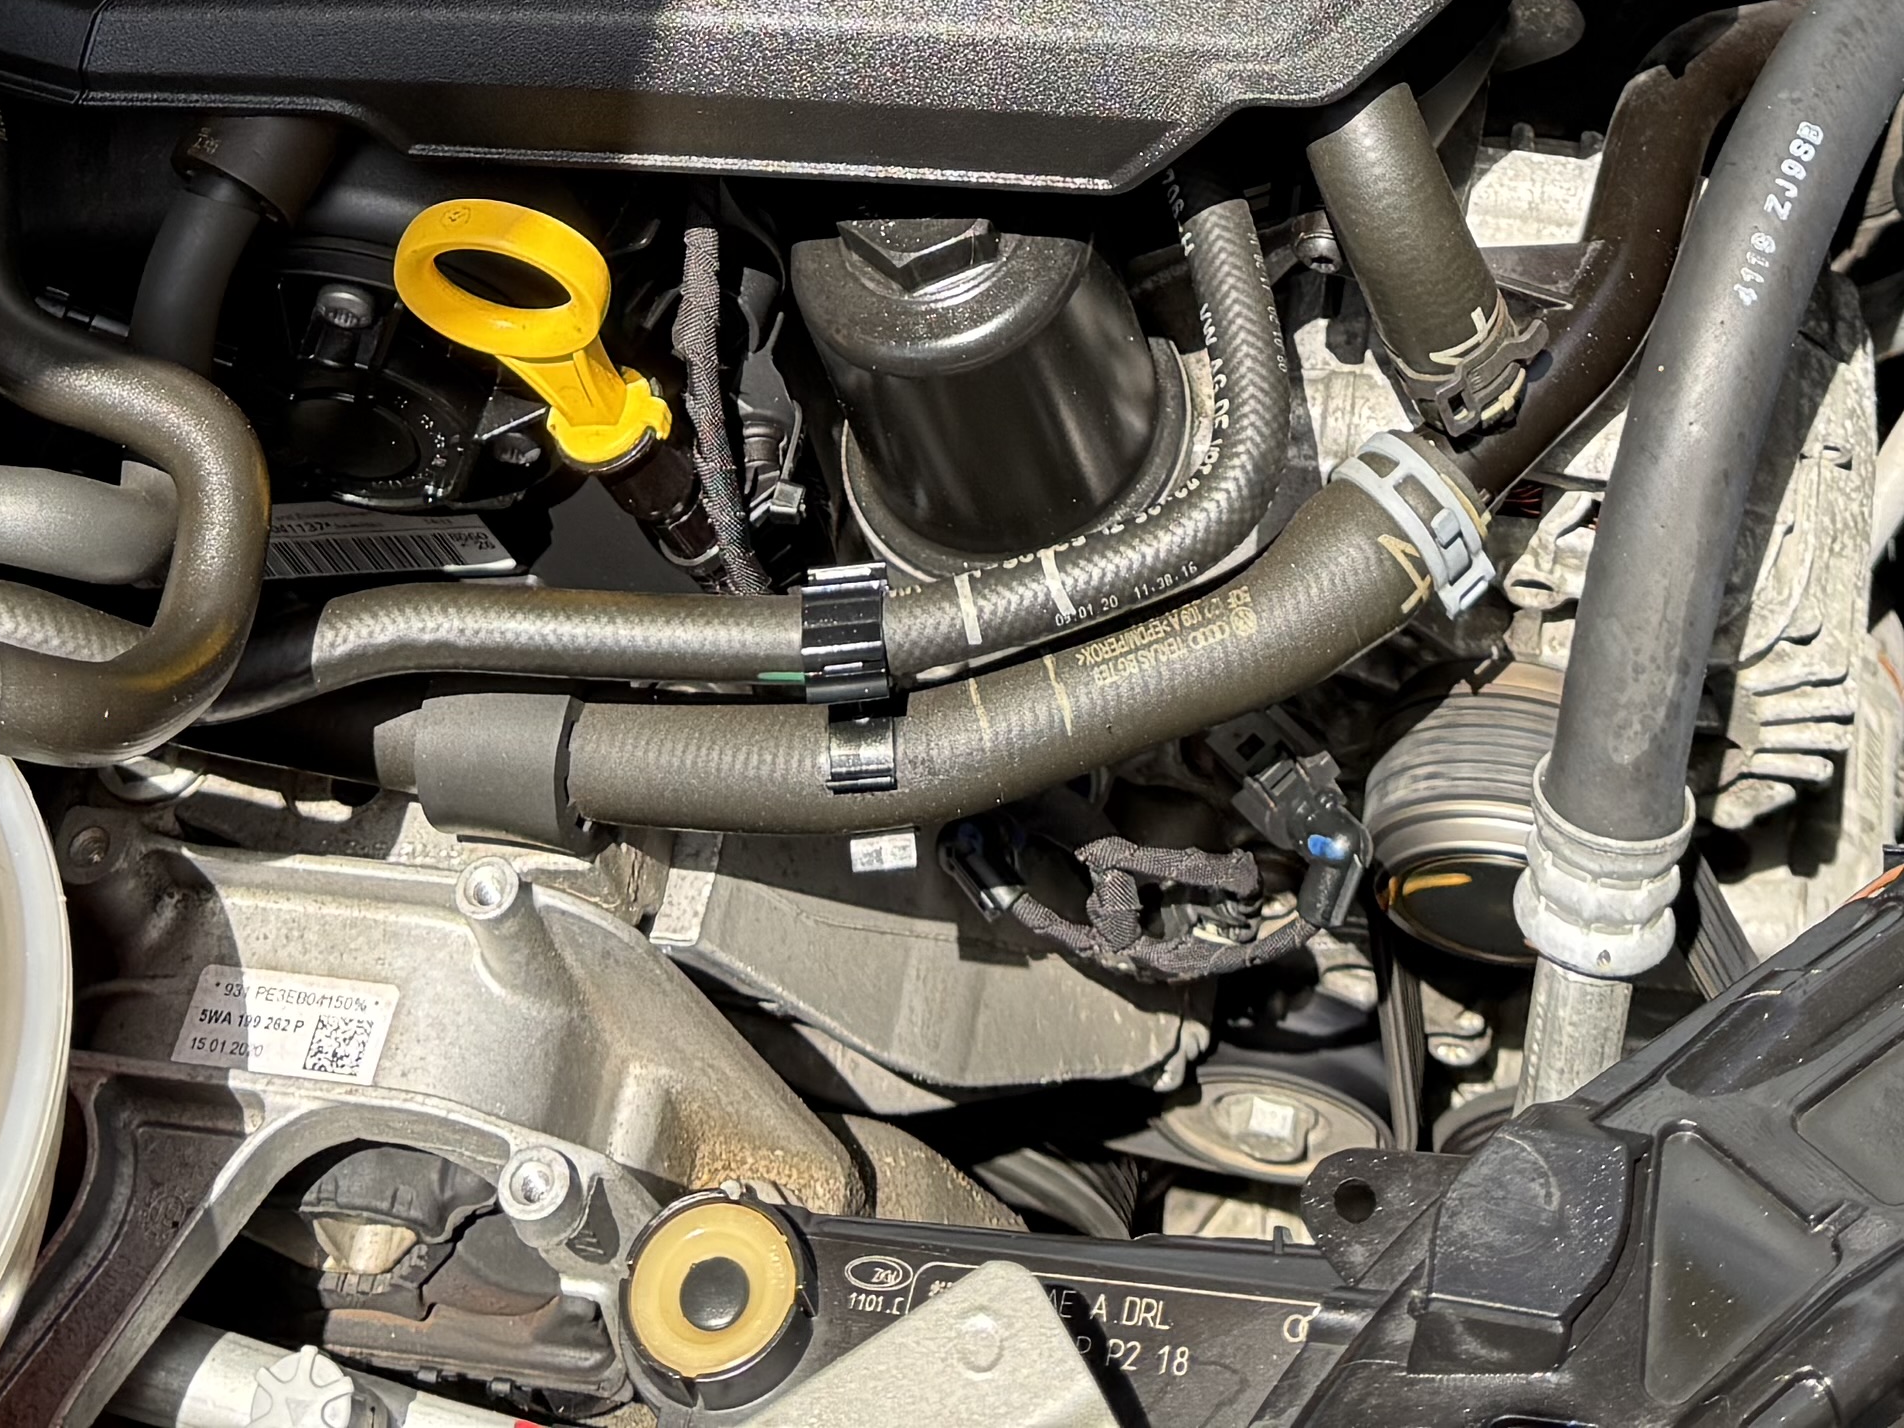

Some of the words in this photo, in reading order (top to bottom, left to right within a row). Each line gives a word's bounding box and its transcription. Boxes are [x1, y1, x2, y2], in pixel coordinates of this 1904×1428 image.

[198, 1008, 233, 1026] 5WA
[292, 1019, 306, 1034] P
[1106, 1338, 1139, 1372] P2
[1157, 1344, 1190, 1377] 18
